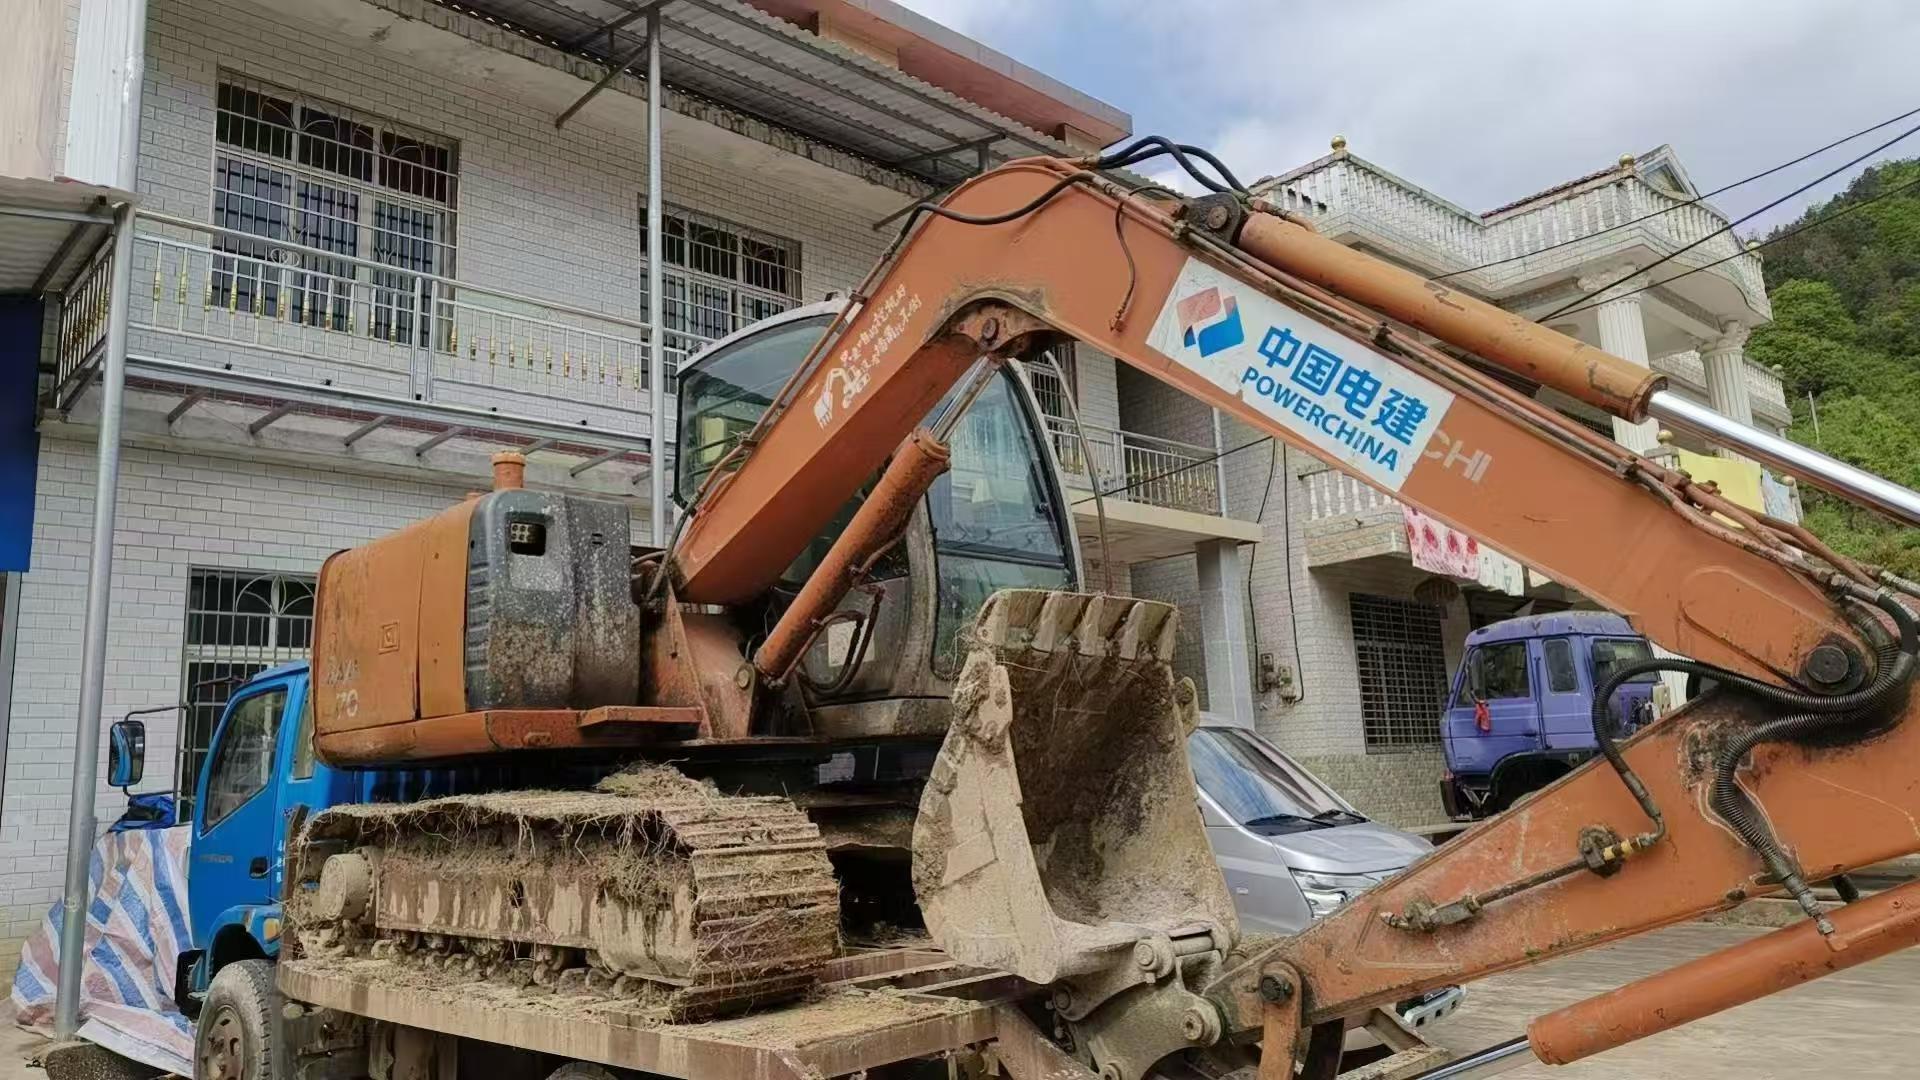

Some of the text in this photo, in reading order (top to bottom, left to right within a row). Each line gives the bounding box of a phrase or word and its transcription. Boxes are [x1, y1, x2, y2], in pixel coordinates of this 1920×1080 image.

[1241, 366, 1398, 471] POWERCHINA
[1257, 325, 1430, 446] 中国电建
